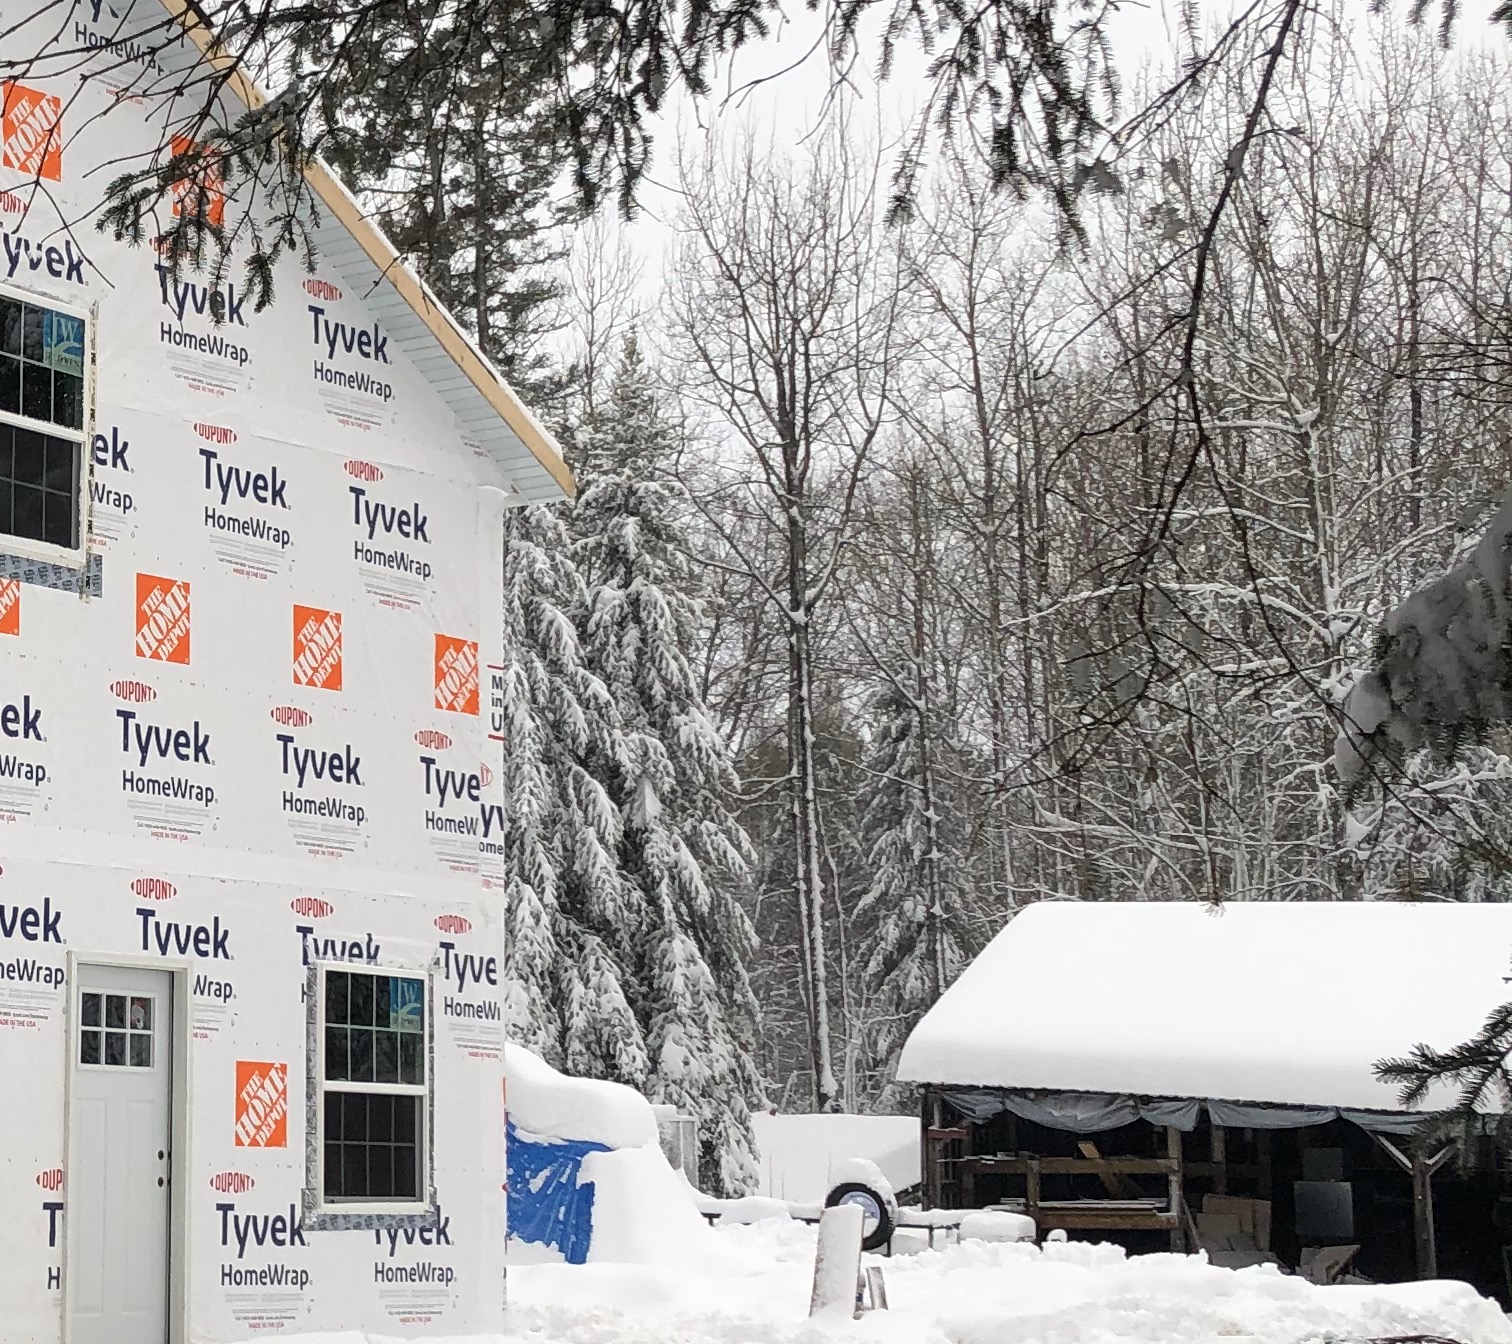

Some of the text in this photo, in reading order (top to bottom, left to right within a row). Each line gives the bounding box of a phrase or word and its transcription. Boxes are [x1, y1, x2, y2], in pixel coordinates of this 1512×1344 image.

[8, 96, 32, 128] THE
[3, 96, 60, 171] HOME
[306, 281, 338, 299] DUPONT
[161, 320, 248, 366] HomeWrap
[308, 305, 388, 364] Tyvek
[315, 359, 391, 402] HomeWrap
[198, 424, 232, 444] DUPONT
[200, 449, 287, 508] Tyvek
[348, 460, 379, 480] DUPONT
[205, 506, 289, 549] HomeWrap
[349, 486, 428, 542] Tyvek
[355, 540, 430, 581] HomeWrap
[136, 580, 190, 660] HOME
[141, 585, 164, 618] THE
[158, 614, 190, 662] DEPOT
[293, 611, 342, 687] HOME
[297, 616, 318, 646] THE
[313, 645, 342, 689] DEPOT
[435, 640, 478, 711] HOME
[115, 681, 152, 703] DUPONT
[275, 707, 309, 727] DUPONT
[117, 710, 210, 767] Tyvek
[419, 730, 448, 751] DUPONT
[277, 734, 361, 788] Tyvek
[123, 770, 214, 807] HomeWrap
[420, 756, 480, 807] Tyve
[283, 791, 364, 826] HomeWrap
[426, 810, 477, 835] HomeW
[136, 879, 172, 900] DUPONT
[295, 898, 329, 917] DUPONT
[439, 915, 467, 933] DUPONT
[439, 941, 497, 993] Tyve
[235, 1062, 287, 1147] HOME
[241, 1070, 262, 1102] THE
[256, 1099, 287, 1147] DEPOT
[42, 1169, 64, 1191] DUP
[215, 1172, 250, 1192] DUPONT
[216, 1203, 306, 1258] Tyvek
[221, 1264, 308, 1290] HomeWrap
[375, 1262, 453, 1287] HomeWrap
